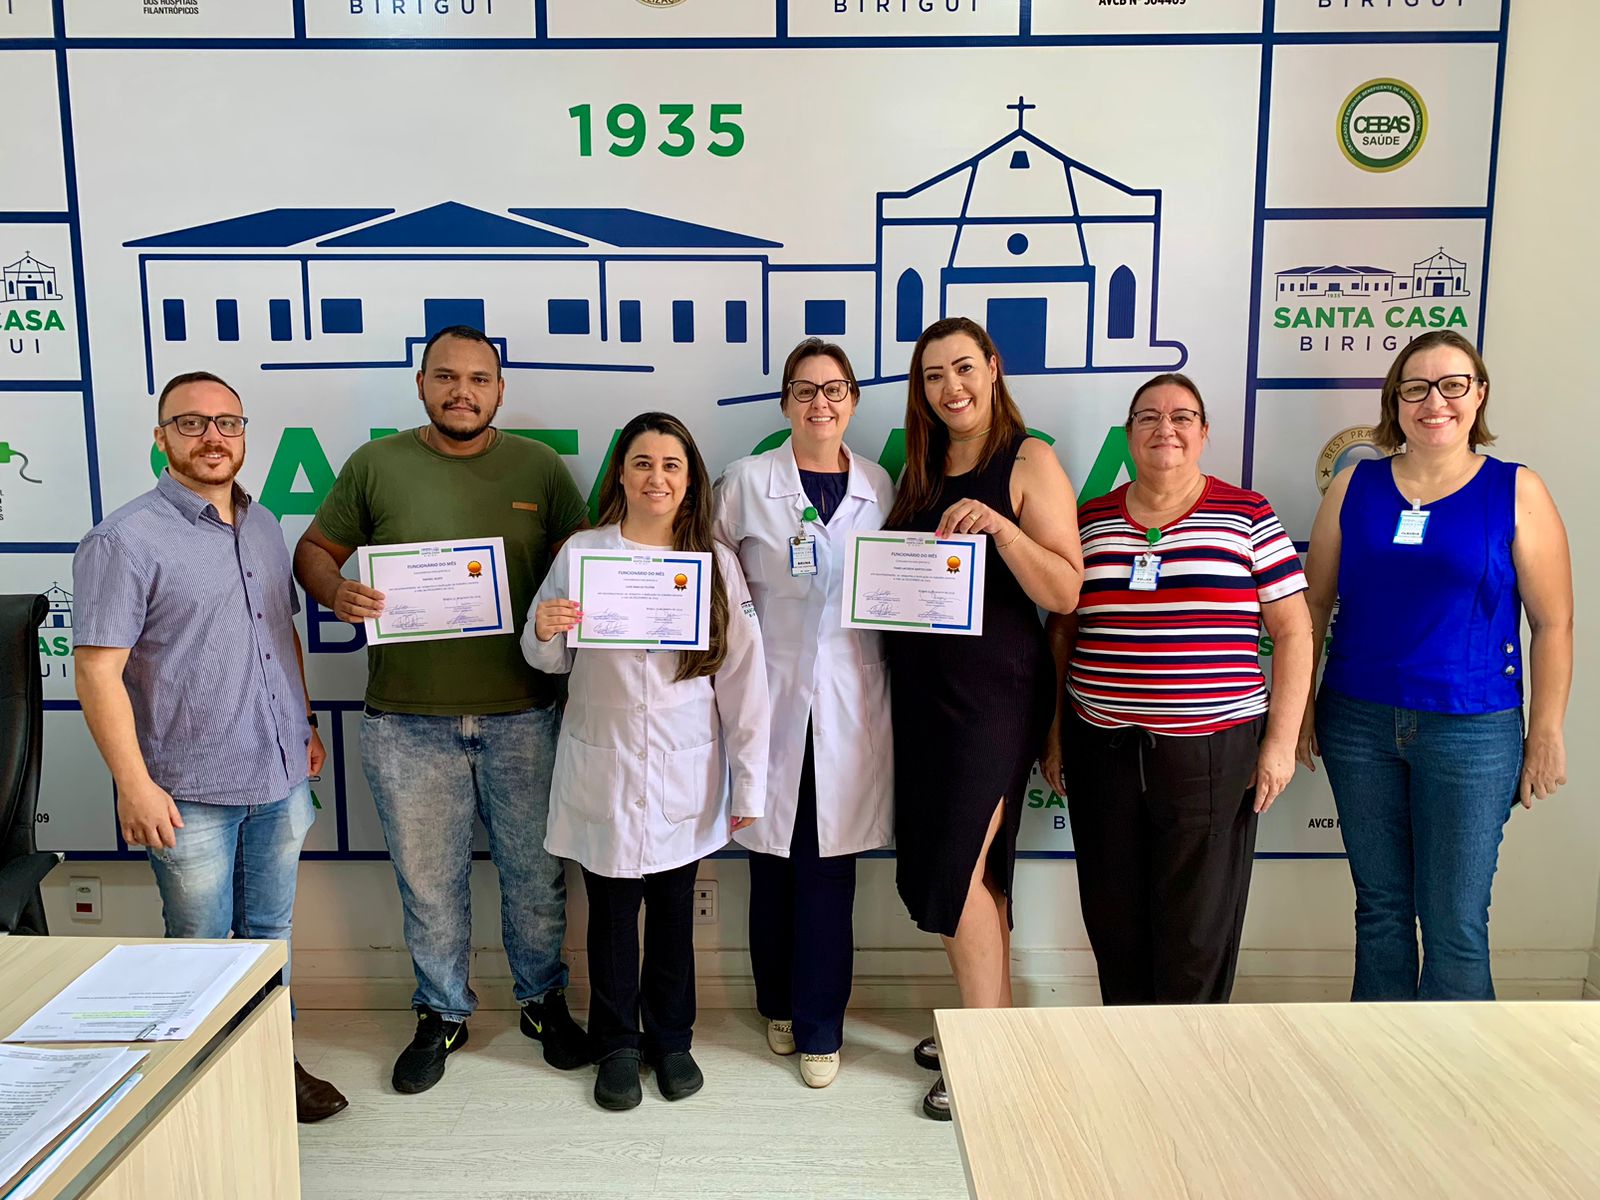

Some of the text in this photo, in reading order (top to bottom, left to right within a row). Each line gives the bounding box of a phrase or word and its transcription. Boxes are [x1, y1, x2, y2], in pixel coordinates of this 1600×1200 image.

[144, 5, 199, 14] FILANTRÓPICOS
[350, 0, 492, 14] BIRIGUI
[568, 103, 744, 157] 1935
[1354, 116, 1410, 134] CEBAS
[1362, 134, 1400, 146] SAÚDE
[0, 310, 65, 330] ASA
[1273, 306, 1468, 328] SANTA CASA
[1300, 336, 1412, 351] BIRIG
[1324, 436, 1344, 460] BEST
[1308, 818, 1334, 828] AVCB
